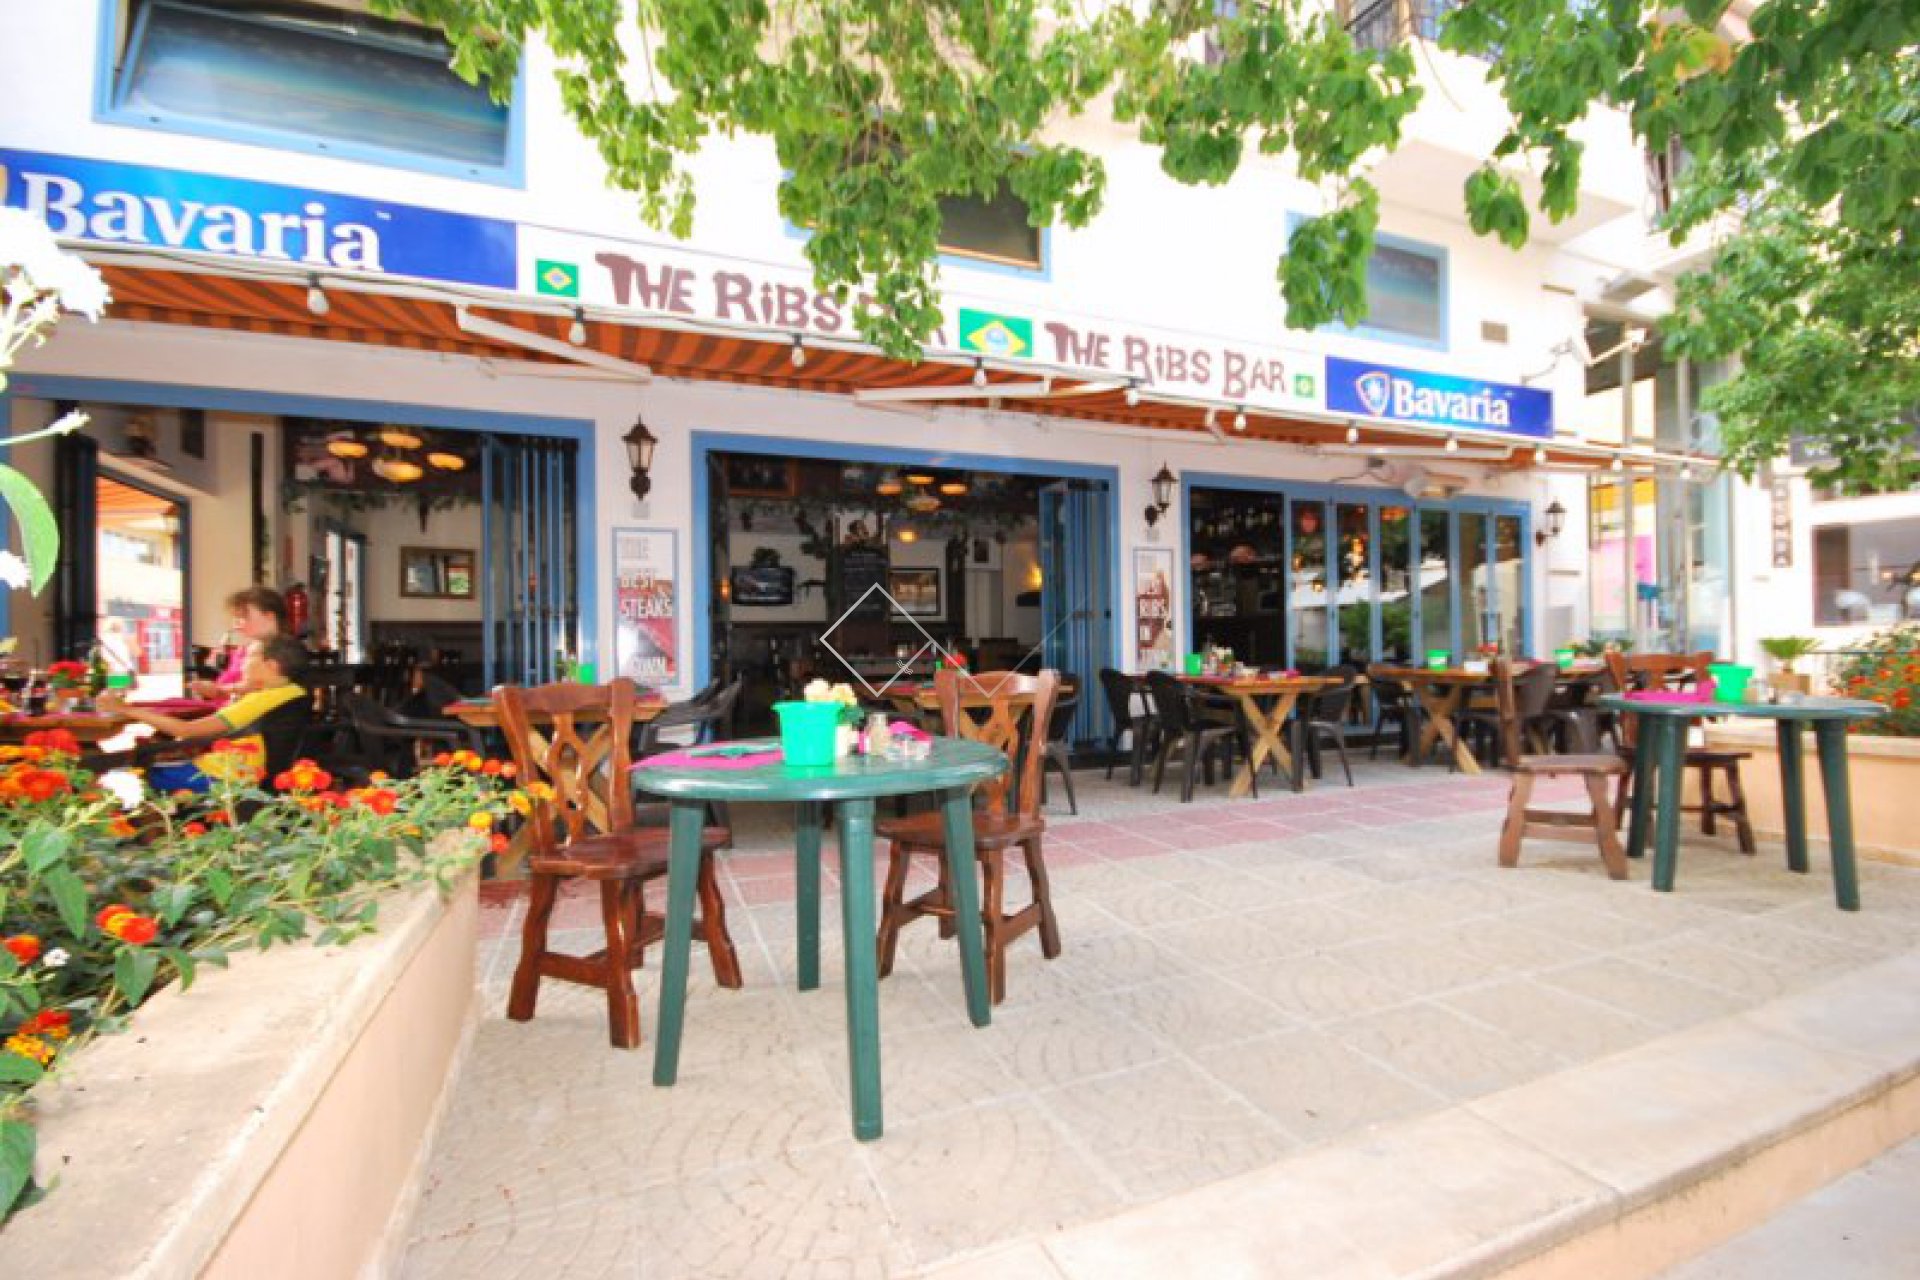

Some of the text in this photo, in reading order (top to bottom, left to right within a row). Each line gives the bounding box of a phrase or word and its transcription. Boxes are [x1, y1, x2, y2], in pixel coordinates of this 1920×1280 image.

[20, 172, 384, 273] Bavaria
[595, 253, 696, 315] THE
[1044, 321, 1110, 368] THE
[1222, 349, 1286, 398] BAR
[1393, 379, 1510, 425] Bavaria
[619, 595, 673, 617] STEAKS
